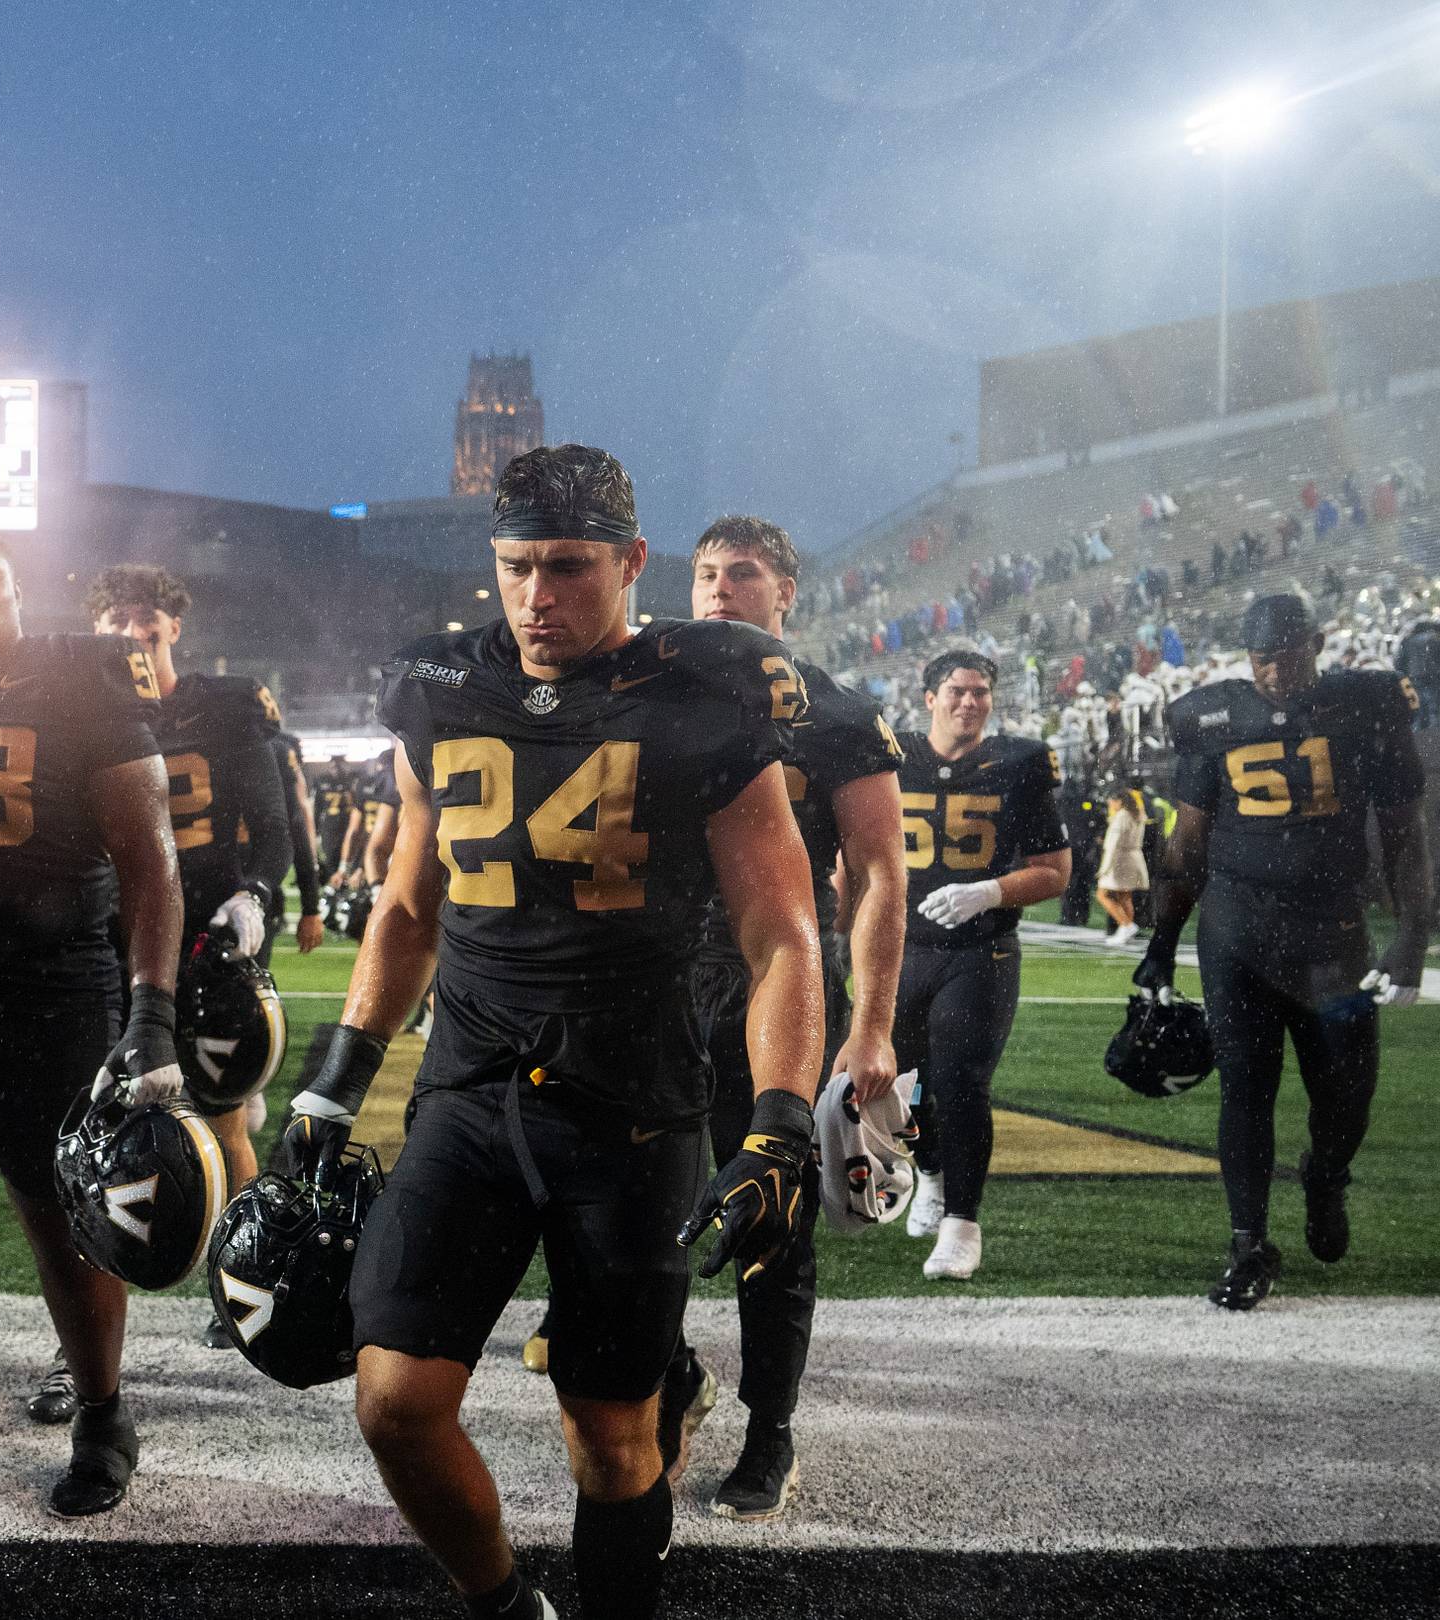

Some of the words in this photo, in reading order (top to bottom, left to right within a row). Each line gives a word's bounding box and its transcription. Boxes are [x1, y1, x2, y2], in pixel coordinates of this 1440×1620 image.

[423, 662, 467, 682] SRM
[531, 684, 556, 707] SEC
[164, 752, 214, 850] 2
[1225, 736, 1343, 817] 51
[431, 736, 650, 912] 24
[901, 791, 1003, 872] 55
